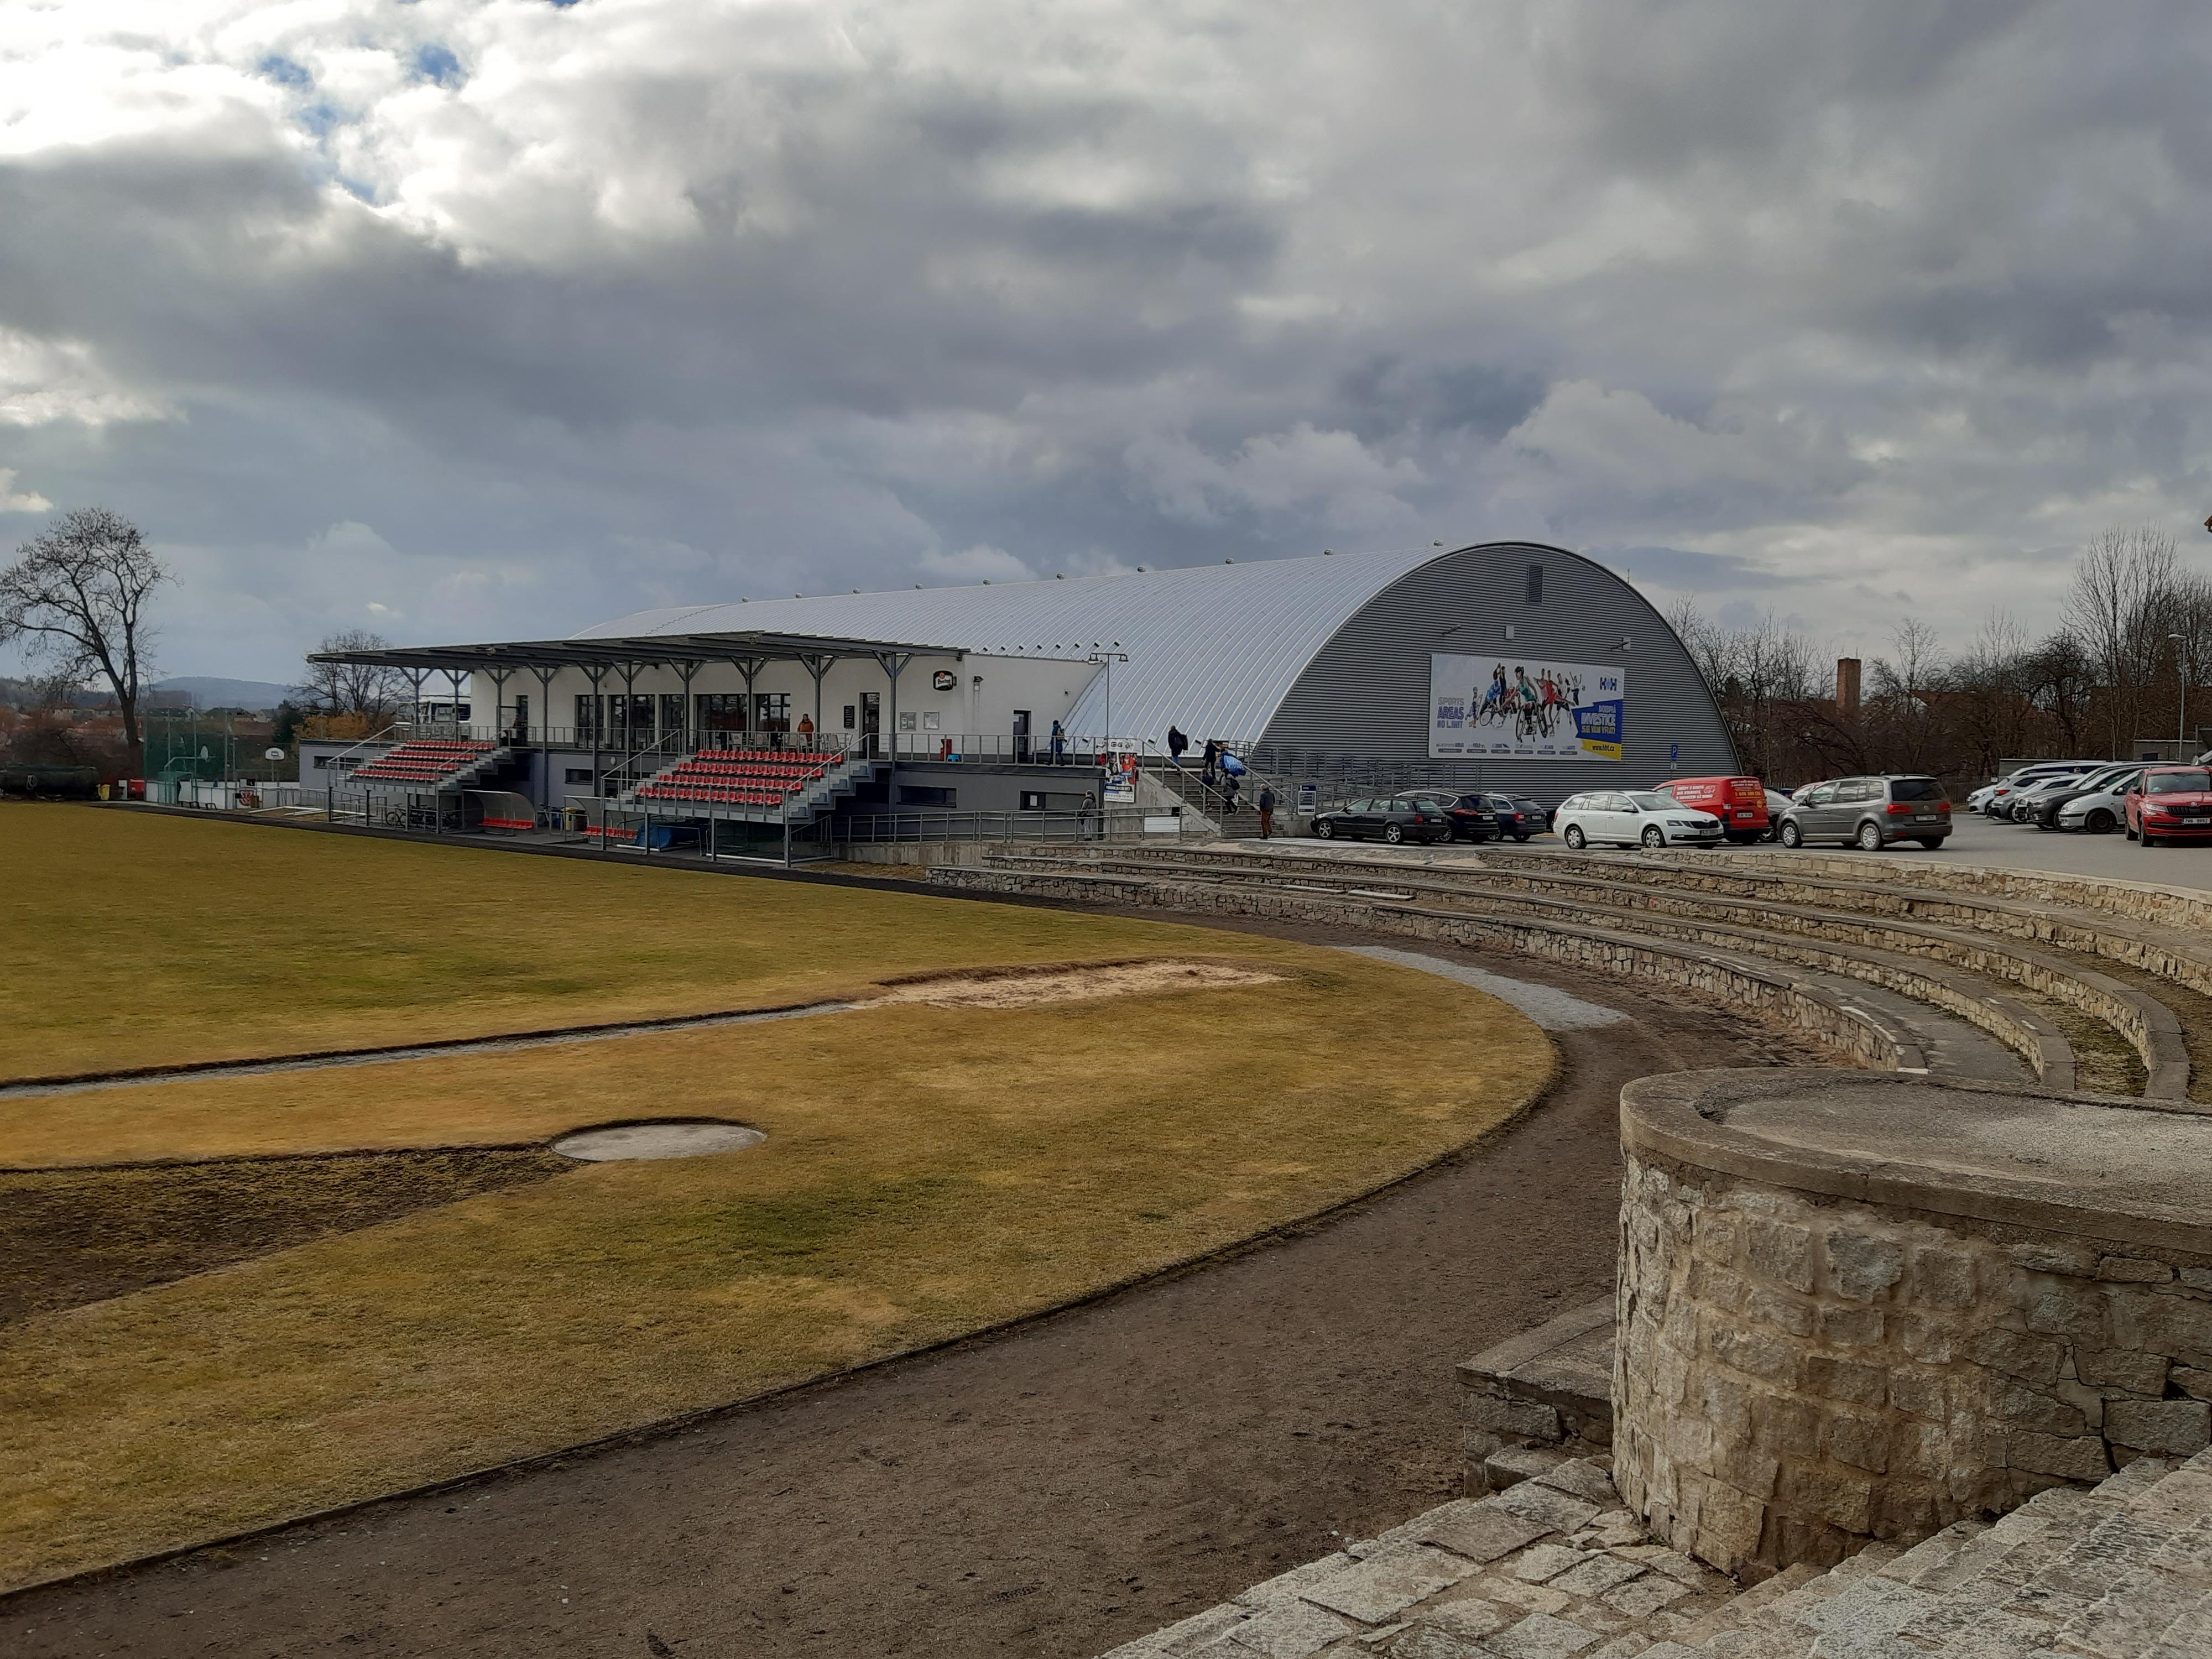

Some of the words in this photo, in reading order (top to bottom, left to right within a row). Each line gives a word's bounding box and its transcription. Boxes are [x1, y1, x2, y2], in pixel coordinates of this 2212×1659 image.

[1437, 697, 1464, 706] SPORTS
[1437, 706, 1464, 720] AREAS
[1437, 720, 1446, 728] NO
[1580, 712, 1616, 727] INVESTICE
[1672, 746, 1677, 757] P
